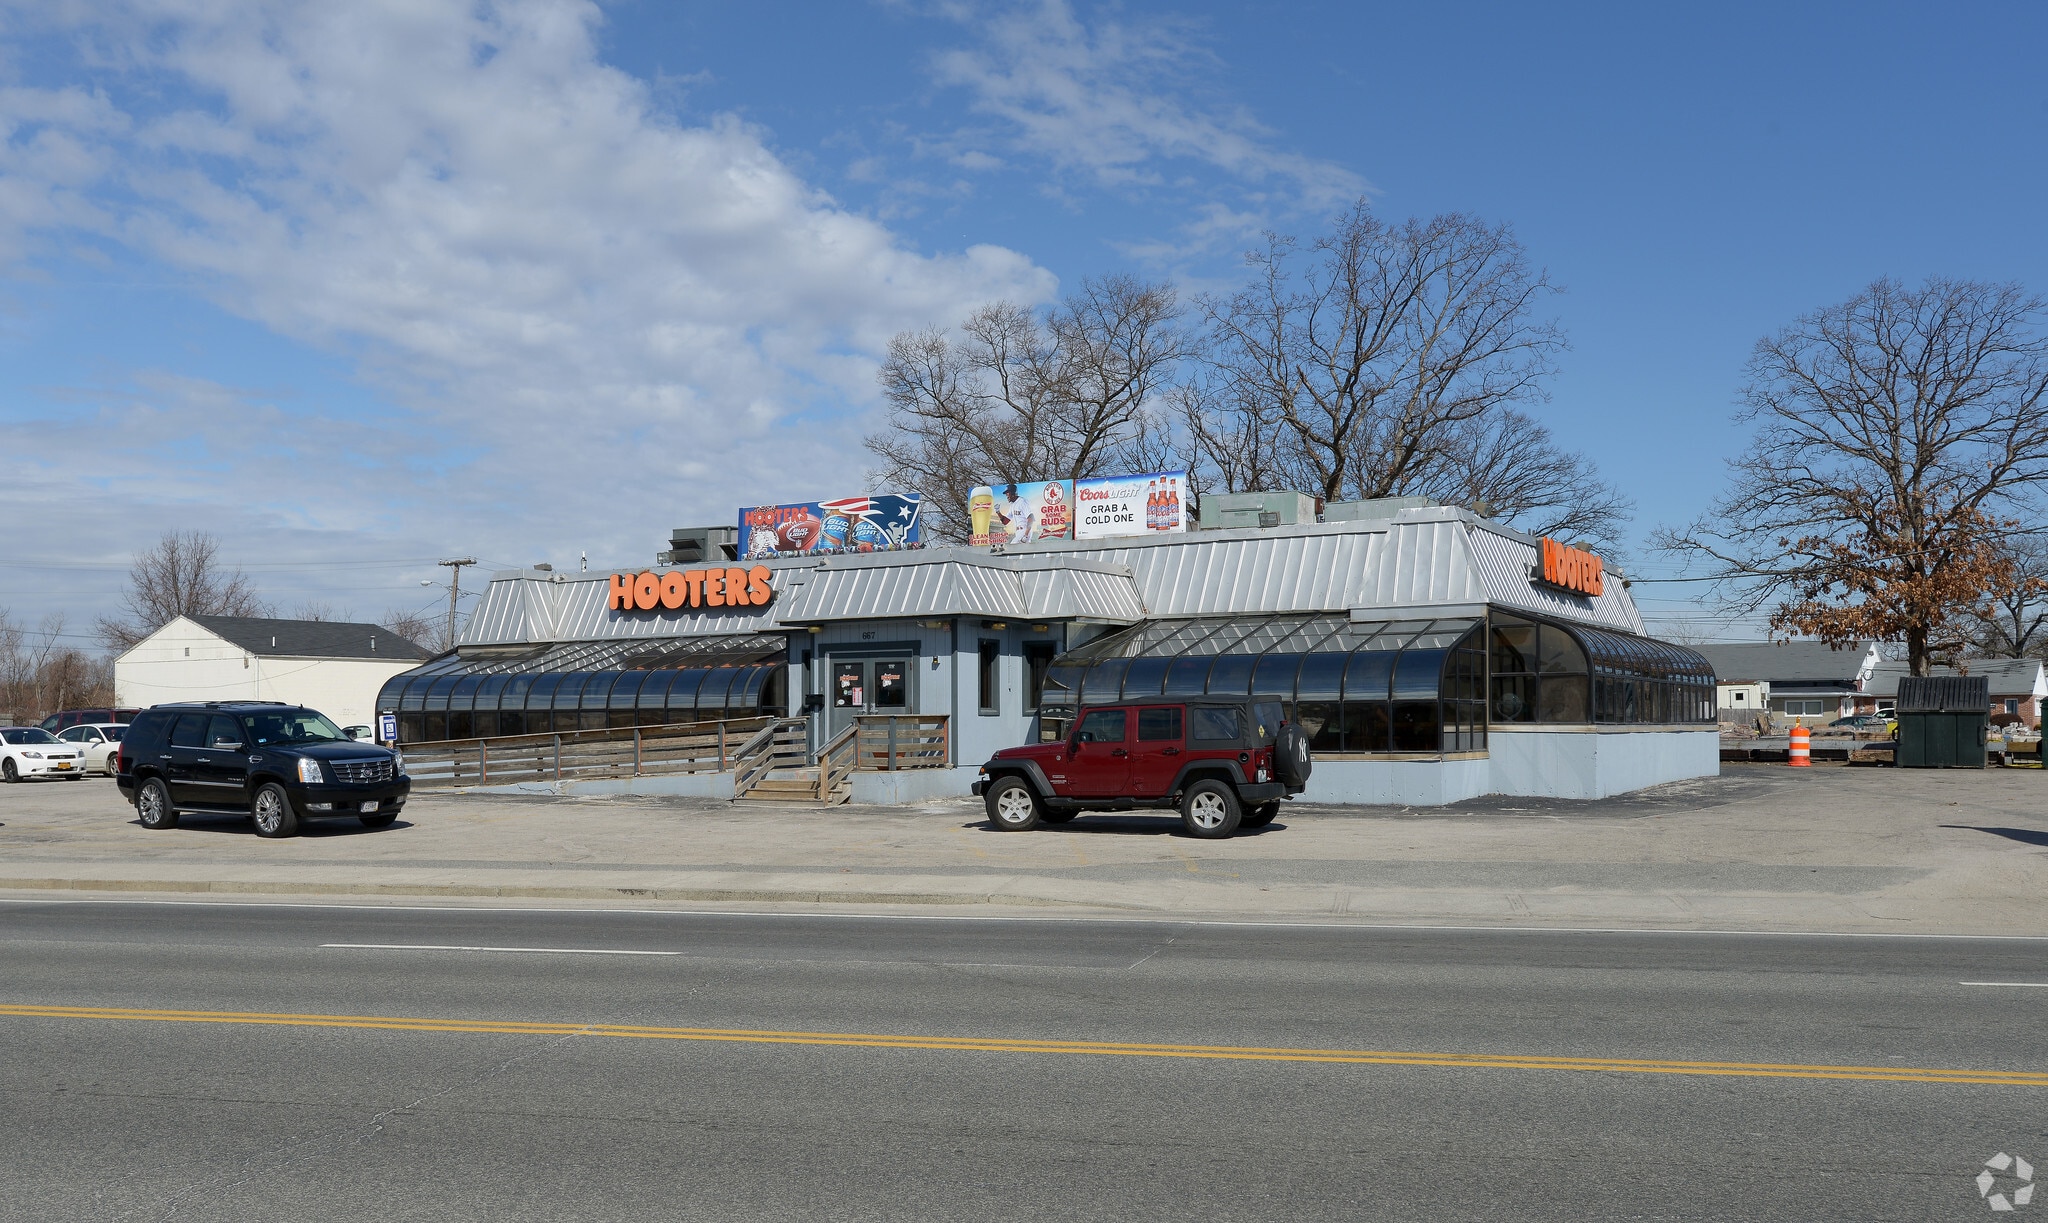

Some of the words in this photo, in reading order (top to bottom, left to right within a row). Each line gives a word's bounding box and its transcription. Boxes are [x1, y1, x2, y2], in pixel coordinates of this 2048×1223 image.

[1080, 488, 1109, 501] Coors
[1109, 488, 1140, 499] LIGHT
[1041, 505, 1066, 513] GRAB
[1091, 504, 1118, 514] GRAB
[1121, 503, 1128, 512] A
[745, 506, 808, 526] HOOTERS
[1041, 517, 1066, 526] BUDS
[1085, 515, 1110, 525] COLD
[1114, 514, 1134, 523] ONE
[827, 519, 849, 527] BUD
[1543, 536, 1604, 597] HOOTERS
[609, 565, 772, 610] HOOTERS
[863, 632, 875, 640] 667
